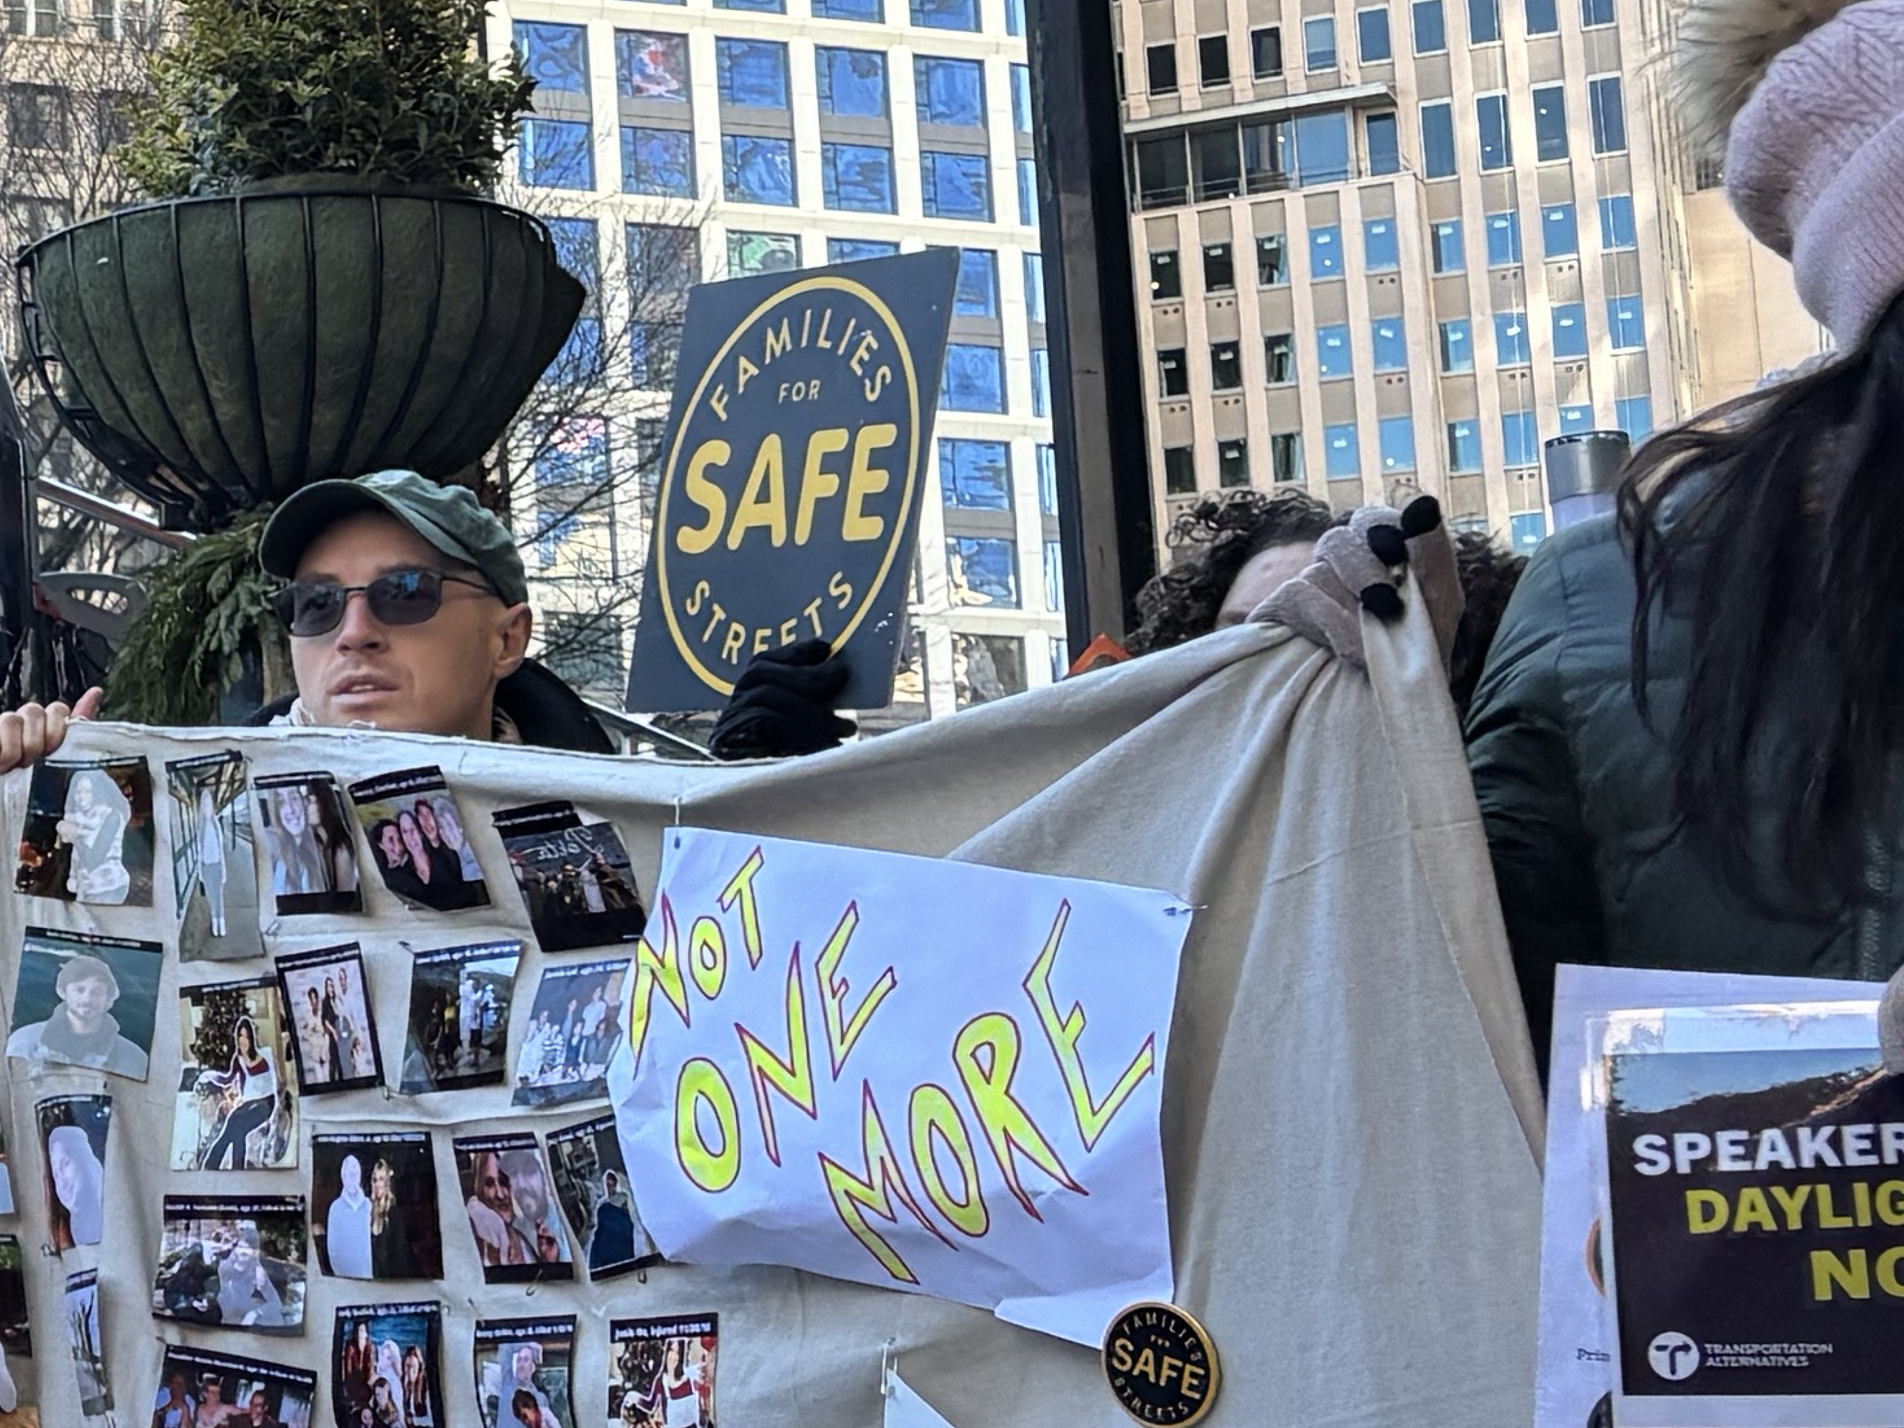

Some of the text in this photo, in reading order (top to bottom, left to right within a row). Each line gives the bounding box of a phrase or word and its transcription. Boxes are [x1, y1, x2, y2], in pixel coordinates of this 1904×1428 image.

[710, 308, 892, 422] FAMILIES
[778, 381, 821, 405] FOR
[675, 423, 898, 555] SAFE
[629, 845, 764, 1080] NOT
[675, 900, 897, 1193] ONE
[818, 899, 1156, 1285] MORE
[1112, 1337, 1206, 1400] SAFE
[1704, 1342, 1834, 1356] TRANSPORTATION
[1704, 1355, 1810, 1368] ALTERNATIVES
